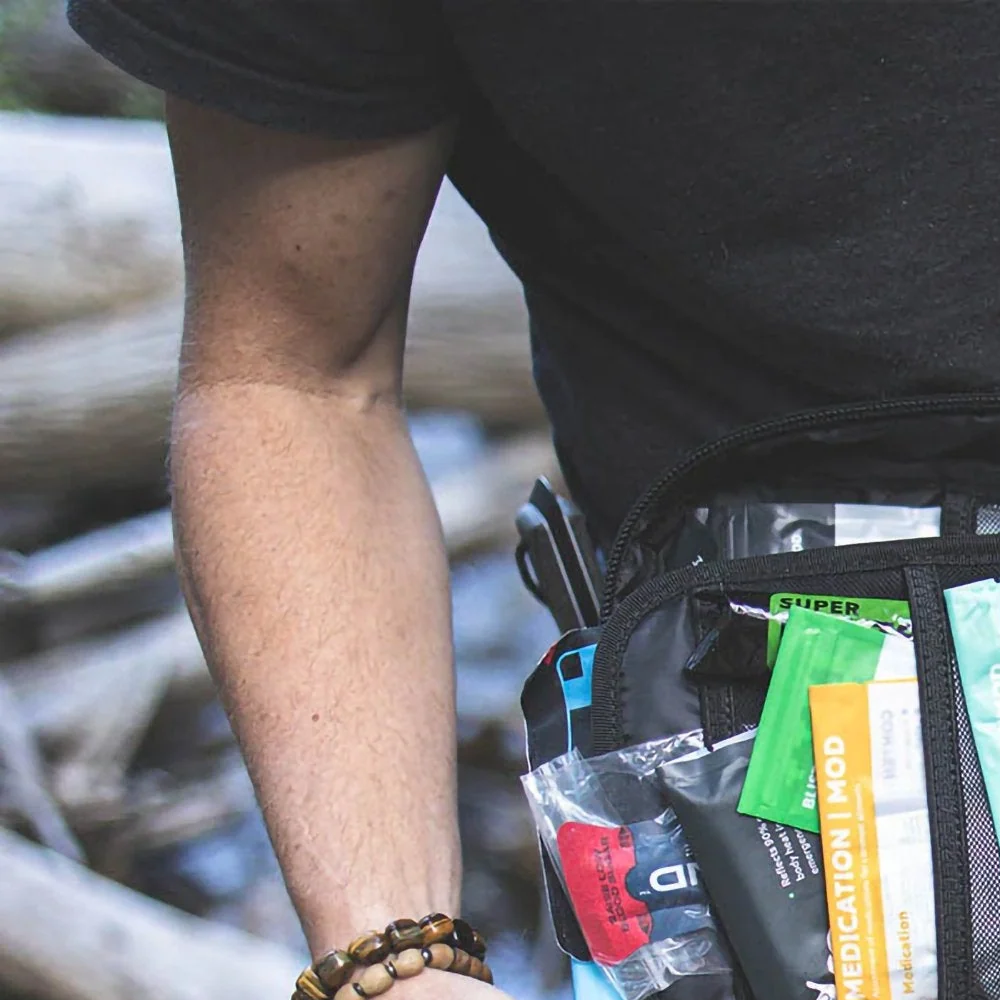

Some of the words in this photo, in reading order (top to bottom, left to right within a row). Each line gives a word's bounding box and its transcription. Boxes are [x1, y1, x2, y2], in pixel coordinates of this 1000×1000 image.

[779, 597, 860, 616] SUPER
[823, 735, 849, 804] MOD
[778, 831, 796, 856] heat
[768, 845, 792, 888] Reflects
[788, 855, 805, 882] body
[898, 910, 915, 994] Medication
